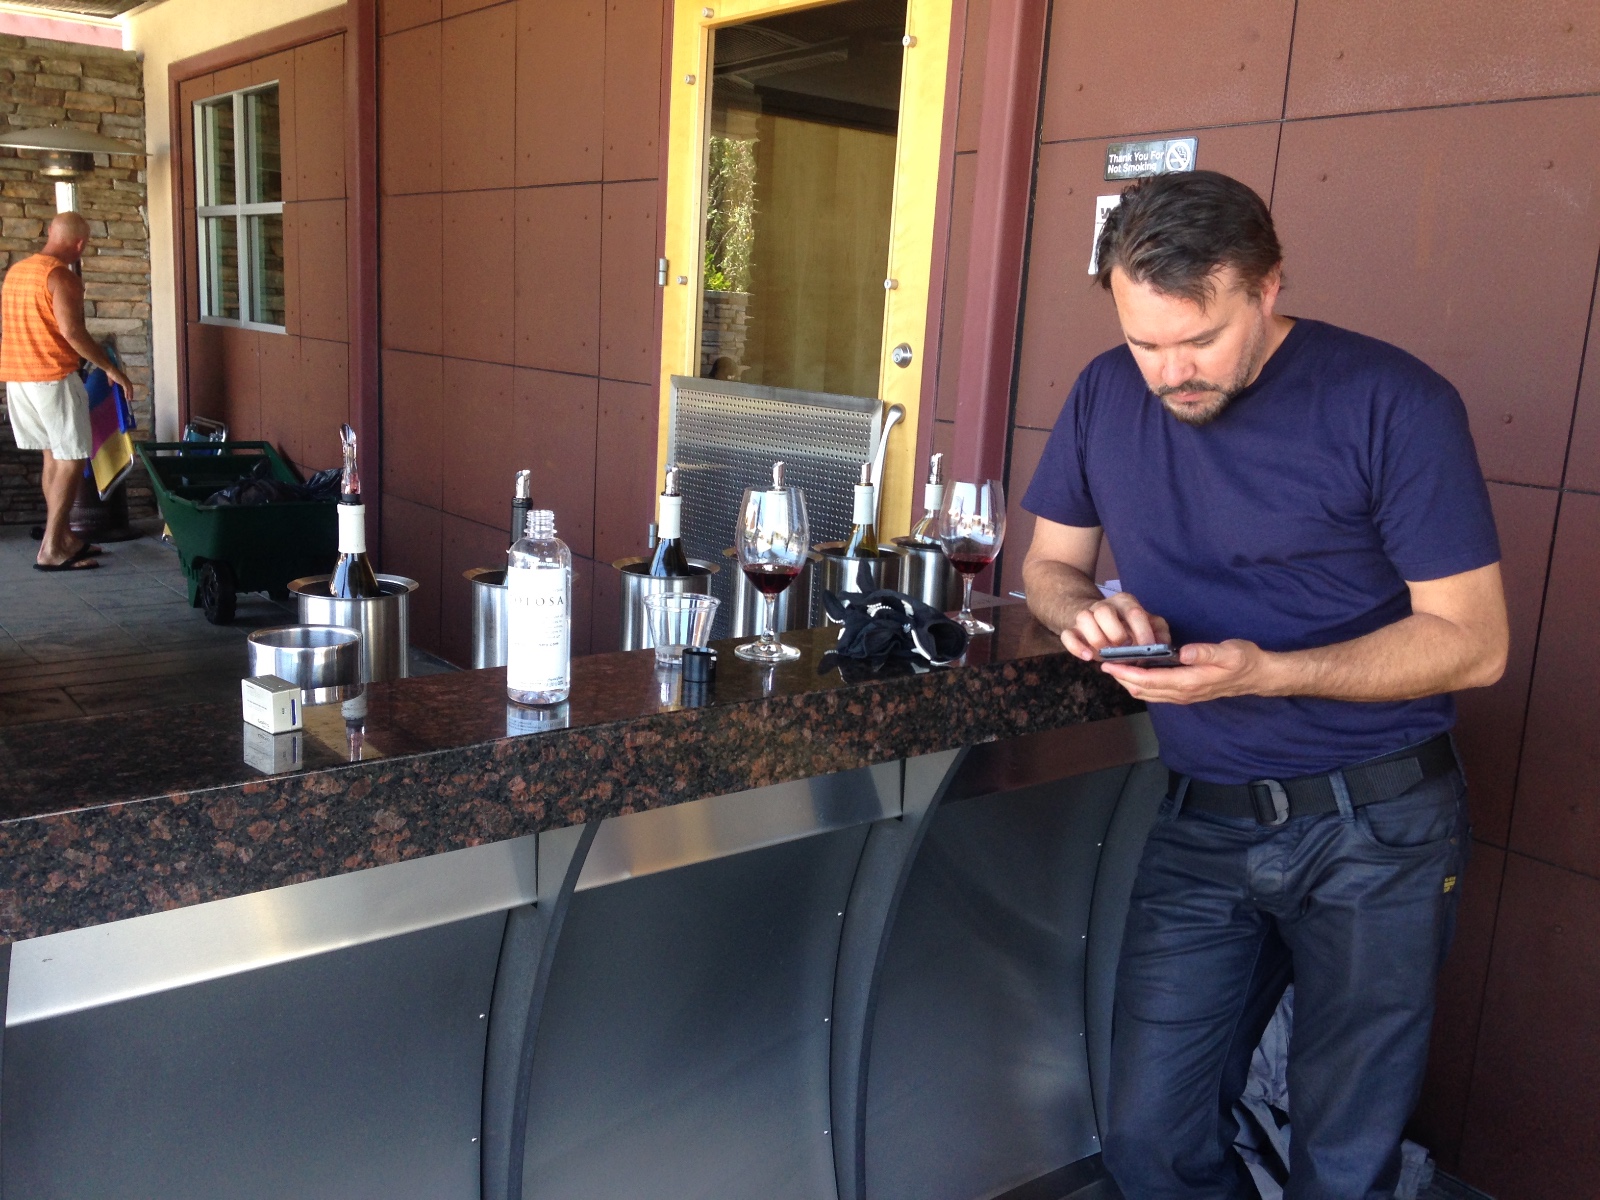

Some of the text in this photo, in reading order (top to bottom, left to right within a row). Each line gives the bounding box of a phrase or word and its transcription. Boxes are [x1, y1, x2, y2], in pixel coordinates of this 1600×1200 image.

[1109, 150, 1165, 163] Thank You For
[1108, 162, 1157, 173] Not Smoking
[510, 595, 564, 607] OLOSA
